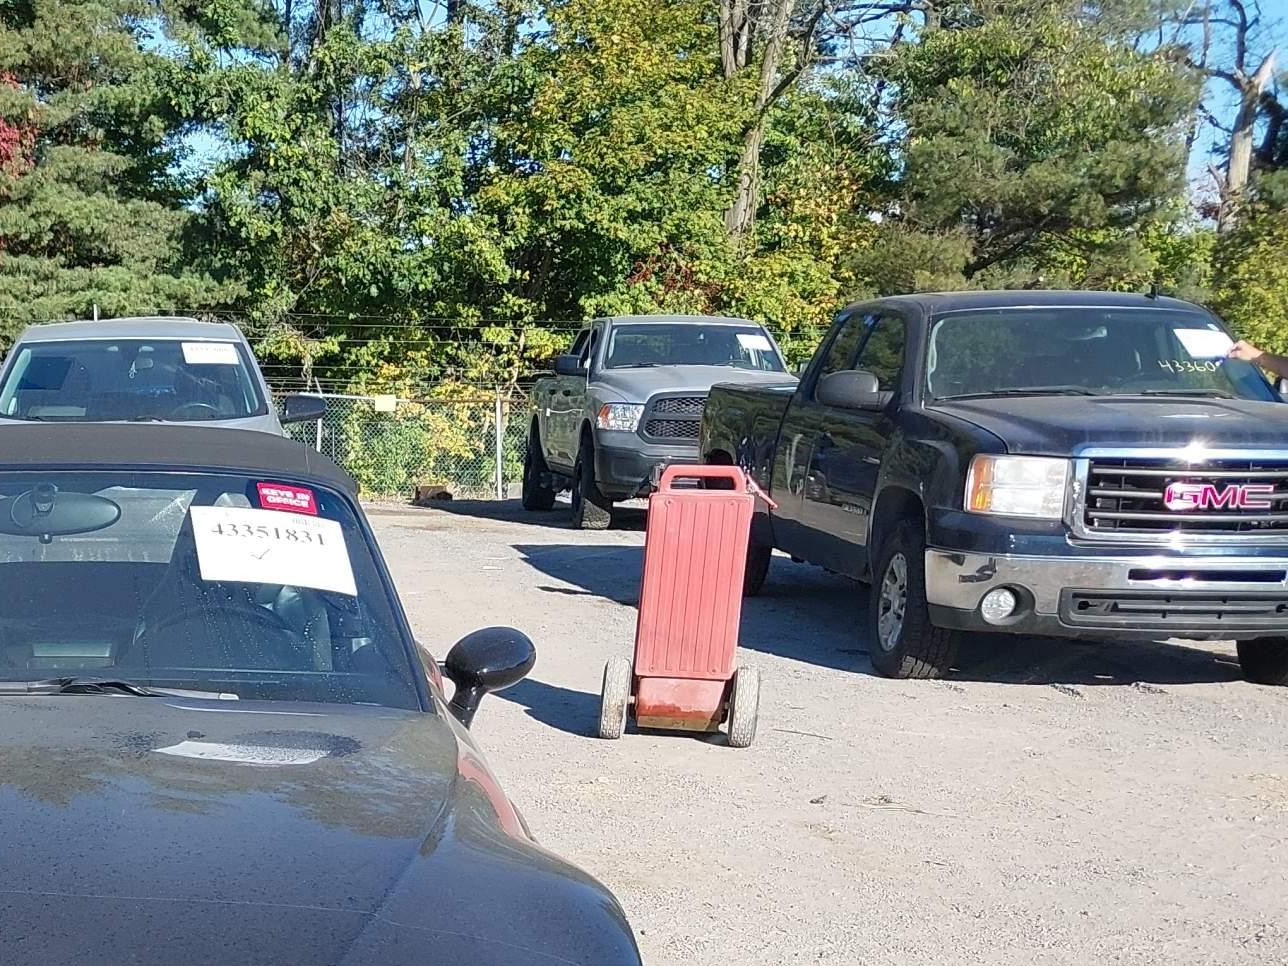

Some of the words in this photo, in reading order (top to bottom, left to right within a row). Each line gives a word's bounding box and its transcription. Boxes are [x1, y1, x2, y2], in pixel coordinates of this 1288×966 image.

[266, 495, 309, 508] OFFICE
[1164, 482, 1274, 511] GMC
[211, 522, 325, 546] 43351831
